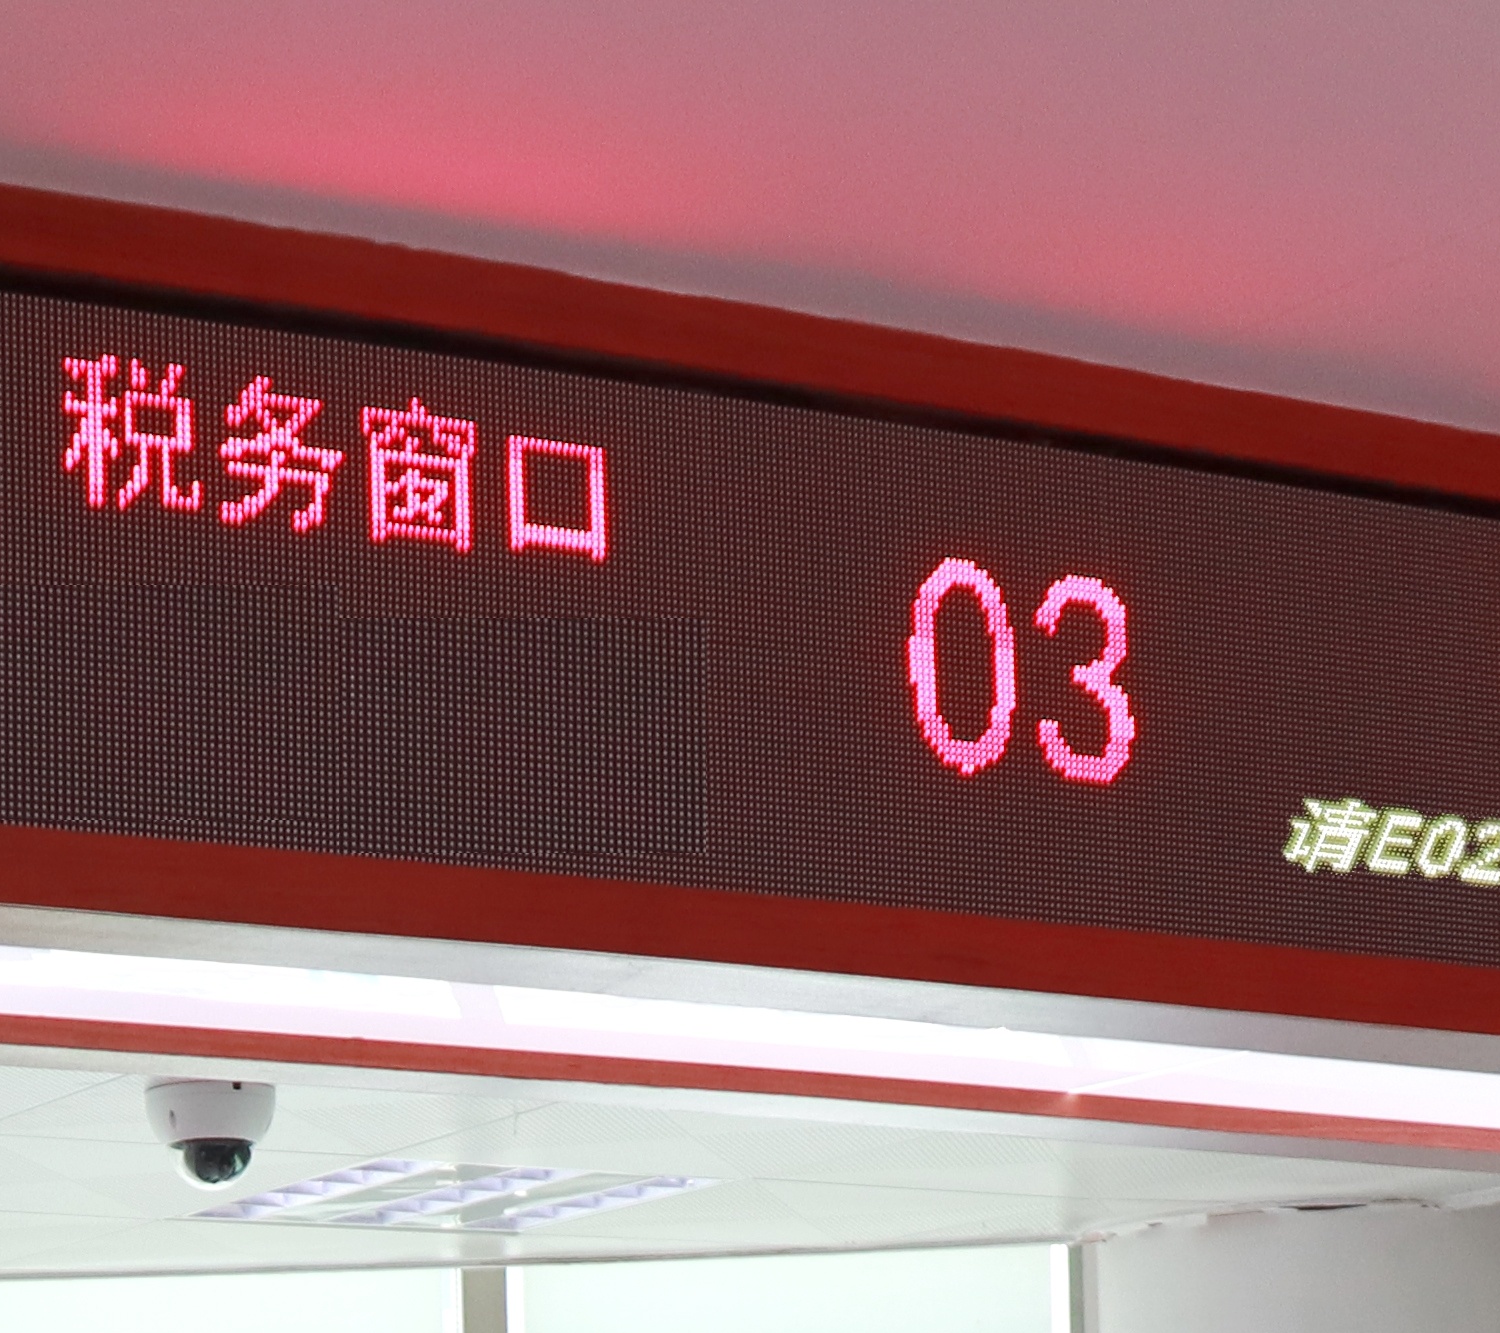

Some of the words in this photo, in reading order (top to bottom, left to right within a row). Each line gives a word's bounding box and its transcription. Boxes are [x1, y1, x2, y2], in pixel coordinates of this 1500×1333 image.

[60, 354, 611, 562] 税务窗口
[906, 557, 1136, 784] 03
